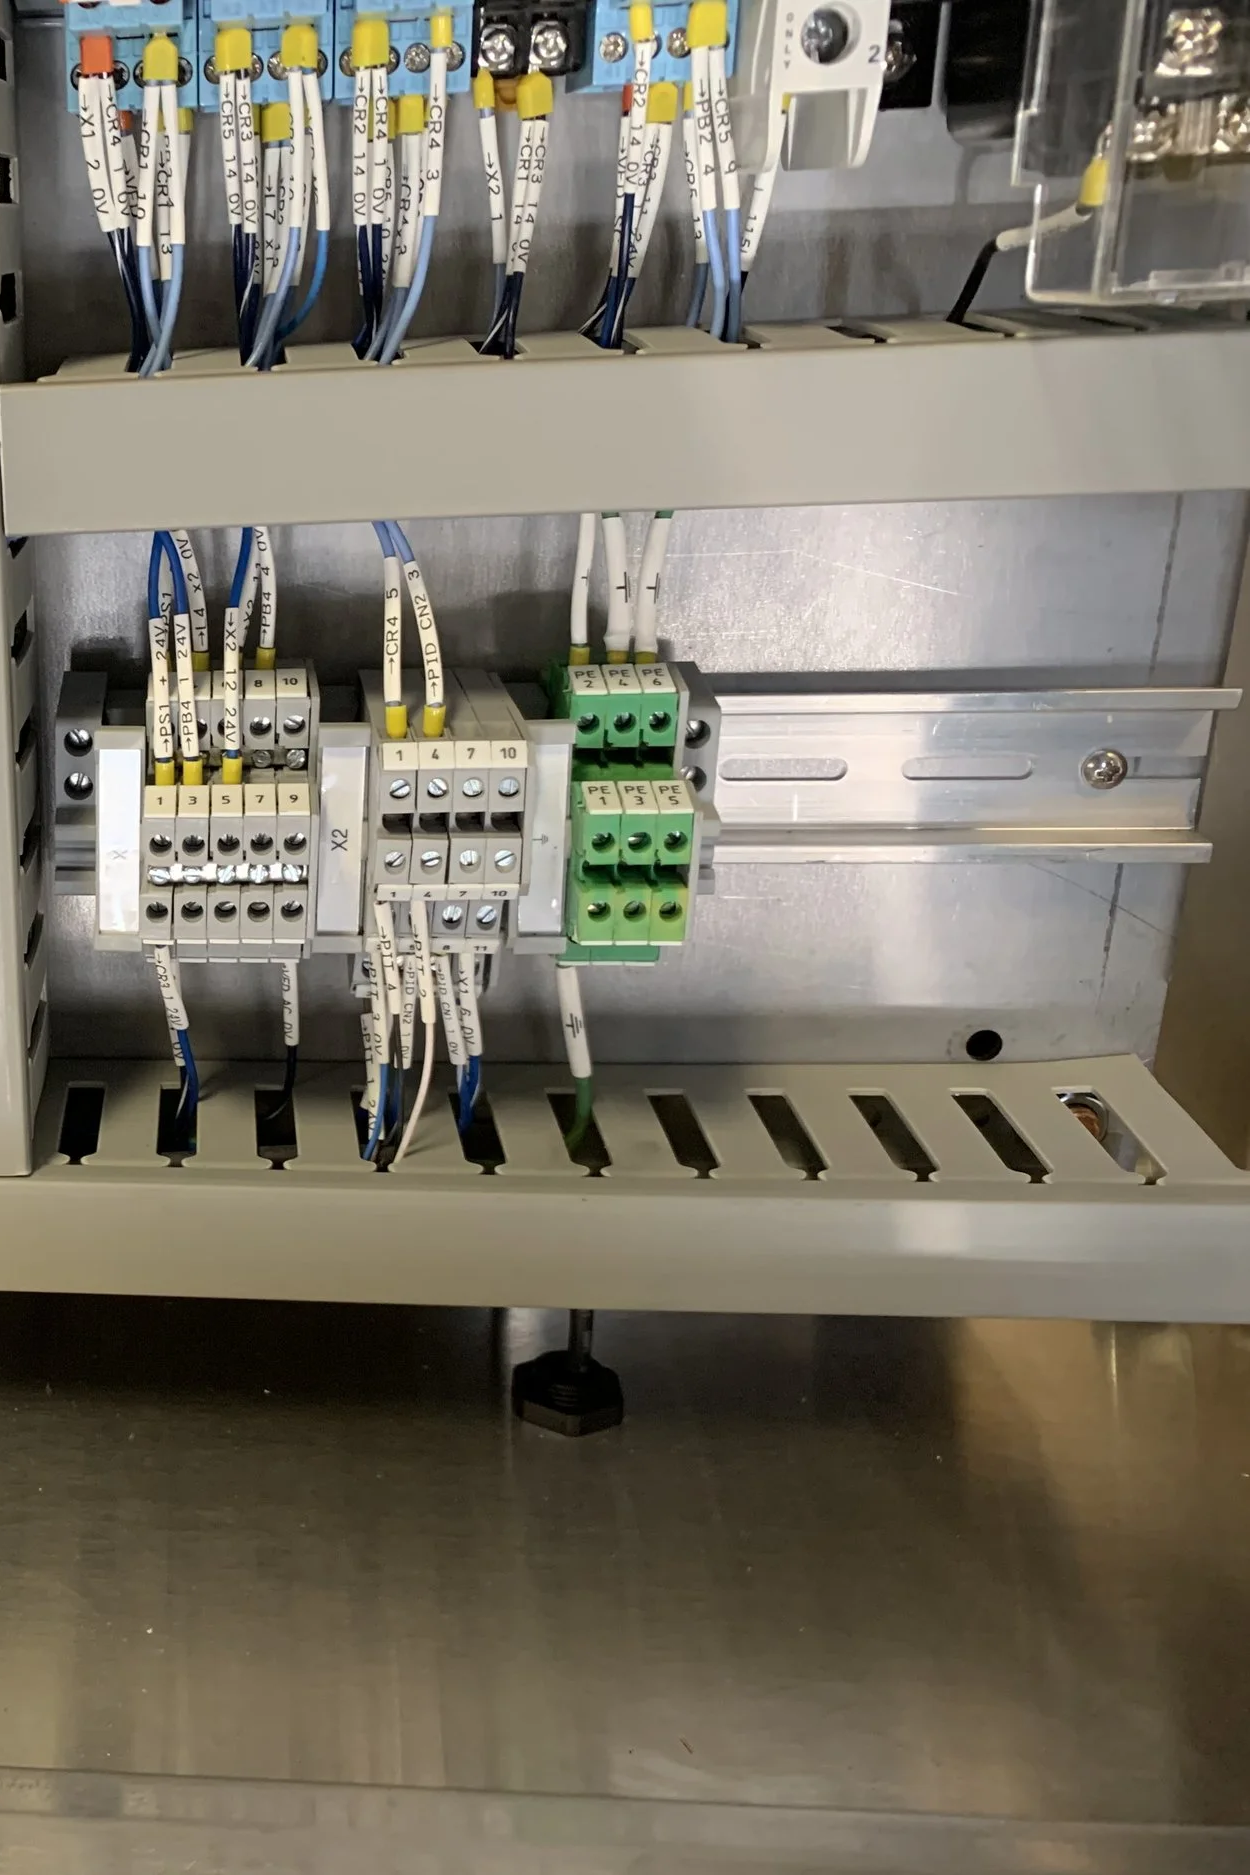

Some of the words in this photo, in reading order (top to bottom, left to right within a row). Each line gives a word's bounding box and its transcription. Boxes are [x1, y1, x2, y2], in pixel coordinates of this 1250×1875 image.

[867, 44, 882, 65] 2
[633, 68, 648, 108] CR2
[80, 113, 96, 138] X1
[105, 103, 122, 147] CR4
[221, 101, 236, 140] CR5
[238, 101, 253, 142] CR3
[354, 94, 368, 135] CR2
[375, 96, 388, 141] CR4
[695, 100, 713, 145] PB2
[713, 98, 733, 145] CR5
[428, 105, 443, 150] CR4
[629, 124, 644, 147] 14
[224, 156, 238, 179] 14
[242, 158, 255, 184] 14
[353, 152, 366, 177] 14
[517, 144, 533, 181] CR1
[530, 144, 547, 185] CR3
[702, 163, 715, 177] 4
[157, 169, 175, 209] CR1
[485, 170, 501, 196] X2
[513, 204, 525, 225] 14
[524, 201, 538, 225] 14
[260, 565, 271, 577] 4
[407, 569, 421, 581] 3
[386, 587, 399, 599] 5
[260, 590, 273, 629] PB4
[414, 593, 434, 632] CN2
[153, 624, 169, 661] 24V
[174, 623, 190, 660] 24V
[225, 628, 238, 652] X2
[385, 615, 399, 656] CR4
[427, 641, 441, 681] PID
[225, 667, 238, 692] 12
[253, 678, 264, 689] 8
[281, 676, 299, 688] 10
[574, 669, 597, 681] PE
[584, 678, 595, 689] 2
[608, 668, 631, 680] PE
[618, 677, 629, 687] 4
[641, 667, 664, 679] PE
[652, 675, 662, 686] 6
[158, 703, 172, 738] PS1
[181, 698, 194, 737] PB4
[224, 706, 238, 744] 24V
[395, 747, 403, 761] 1
[430, 747, 440, 761] 4
[466, 746, 476, 760] 7
[500, 746, 518, 760] 10
[156, 795, 164, 807] 1
[187, 794, 198, 806] 3
[221, 794, 231, 806] 5
[255, 794, 265, 805] 7
[289, 793, 299, 805] 9
[587, 785, 611, 797] PE
[600, 796, 608, 806] 1
[623, 785, 647, 796] PE
[634, 795, 645, 806] 3
[658, 784, 681, 796] PE
[668, 795, 679, 806] 5
[330, 827, 349, 852] X2
[381, 939, 395, 973] PIT
[413, 940, 426, 978] PIT
[405, 970, 416, 996] PID
[437, 973, 448, 995] PID
[402, 1002, 414, 1025] CN2
